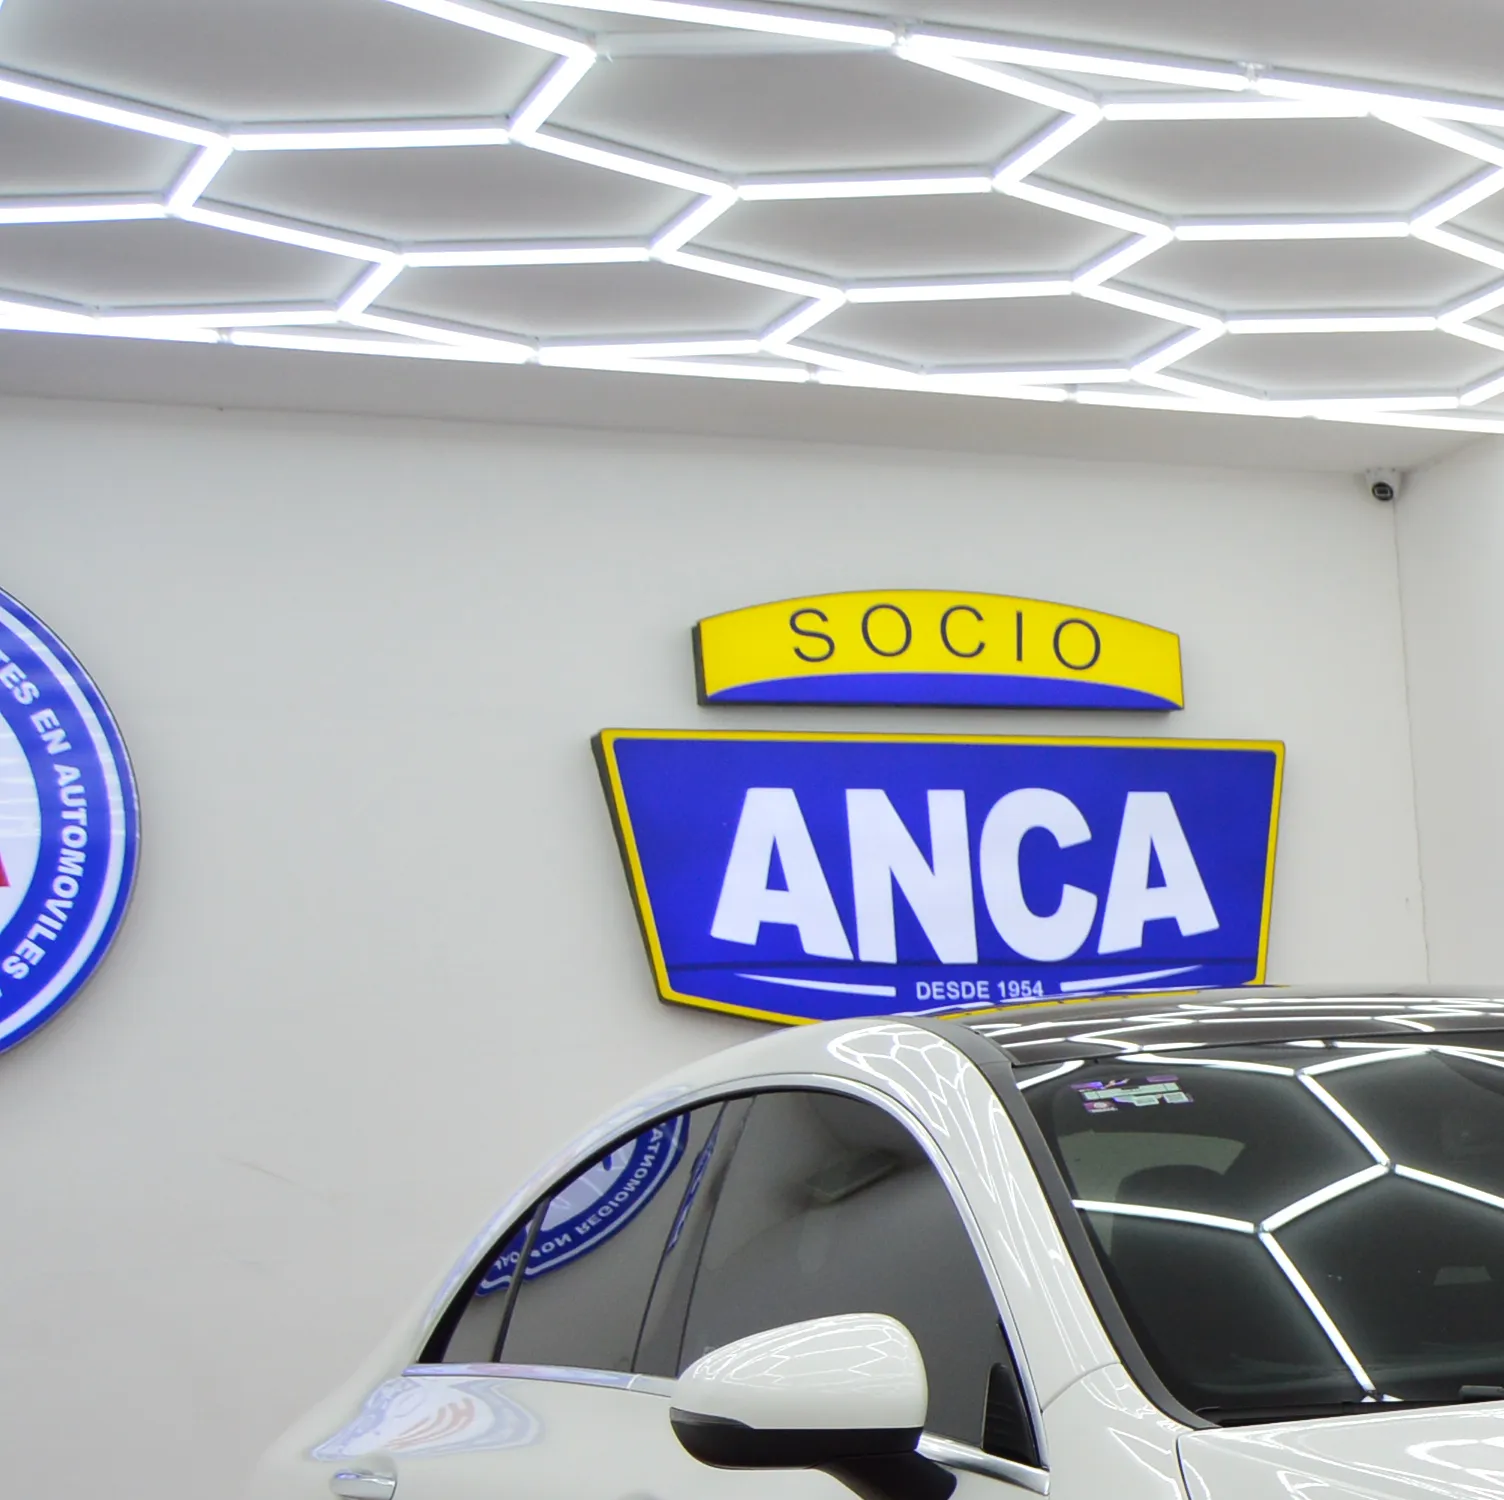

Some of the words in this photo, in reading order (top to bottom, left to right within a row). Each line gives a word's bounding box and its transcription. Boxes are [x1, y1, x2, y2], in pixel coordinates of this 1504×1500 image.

[788, 603, 1102, 671] SOCIO
[30, 708, 72, 756] EN
[2, 763, 88, 980] AUTOMOVILES
[710, 787, 1220, 964] ANCA
[916, 980, 990, 1000] DESDE
[997, 979, 1044, 998] 1954
